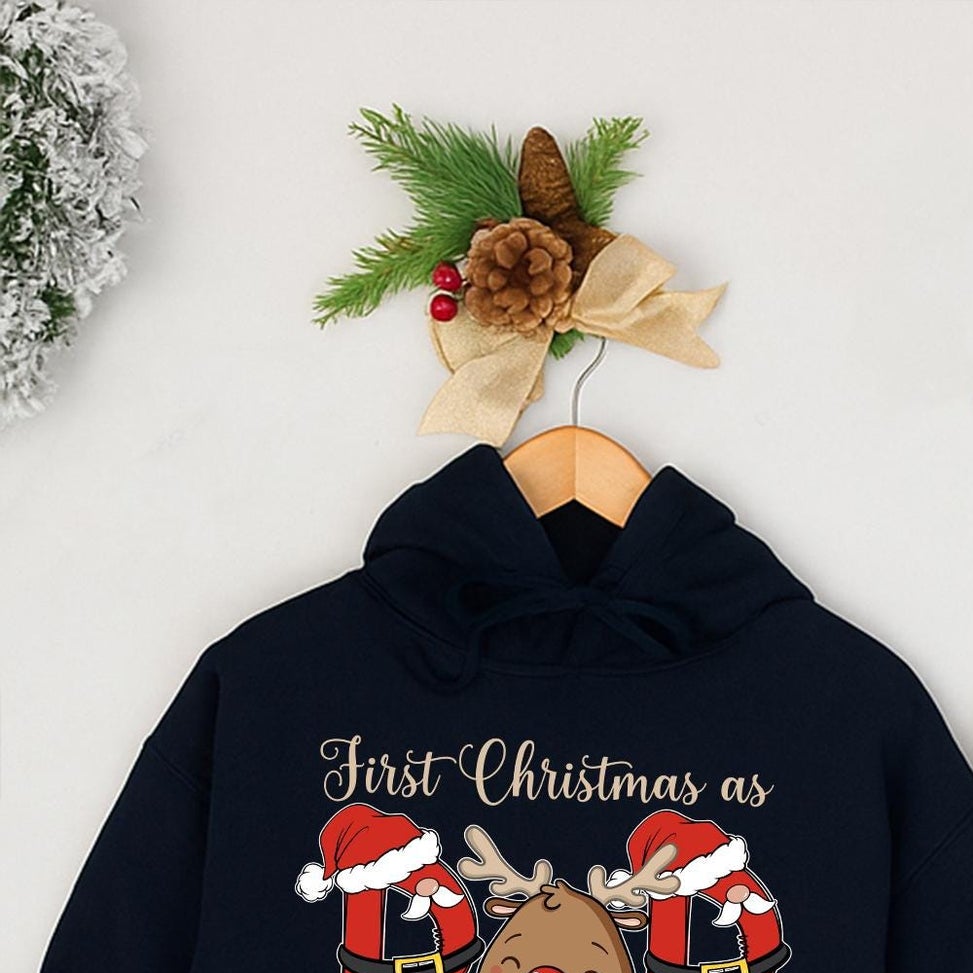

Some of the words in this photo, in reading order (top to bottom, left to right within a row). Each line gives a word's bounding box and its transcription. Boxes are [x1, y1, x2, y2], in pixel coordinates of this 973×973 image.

[320, 735, 457, 802] First
[459, 738, 707, 806] Christmas
[720, 773, 775, 807] as
